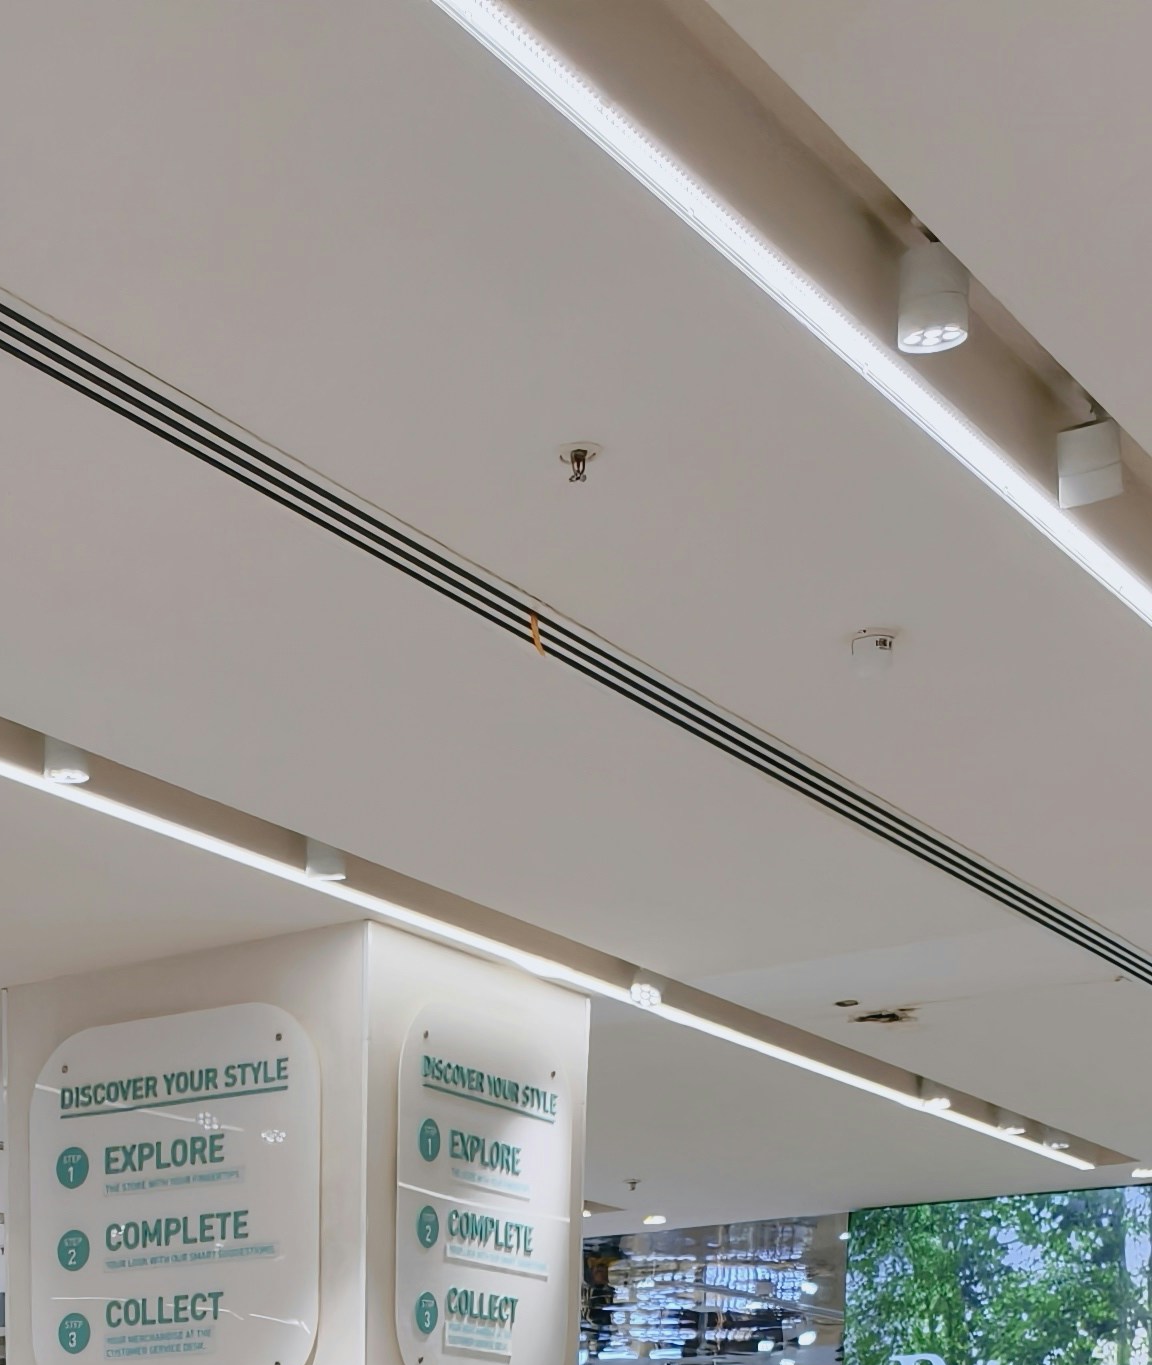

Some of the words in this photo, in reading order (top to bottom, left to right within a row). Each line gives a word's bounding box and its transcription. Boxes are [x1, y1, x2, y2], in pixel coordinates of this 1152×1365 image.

[60, 1076, 158, 1109] DISCOVER
[163, 1068, 218, 1096] YOUR
[224, 1057, 289, 1088] STYLE
[422, 1055, 485, 1093] DISCOVER
[487, 1074, 519, 1104] YOUR
[521, 1085, 558, 1116] STYLE
[104, 1133, 225, 1175] EXPLORE
[428, 1138, 432, 1157] 1
[449, 1129, 521, 1176] EXPLORE
[67, 1166, 74, 1183] 1
[105, 1210, 249, 1251] COMPLETE
[425, 1225, 431, 1242] 2
[448, 1209, 534, 1253] COMPLETE
[68, 1248, 77, 1266] 2
[105, 1291, 224, 1328] COLLECT
[424, 1311, 431, 1328] 3
[447, 1287, 519, 1323] COLLECT
[68, 1332, 77, 1348] 3
